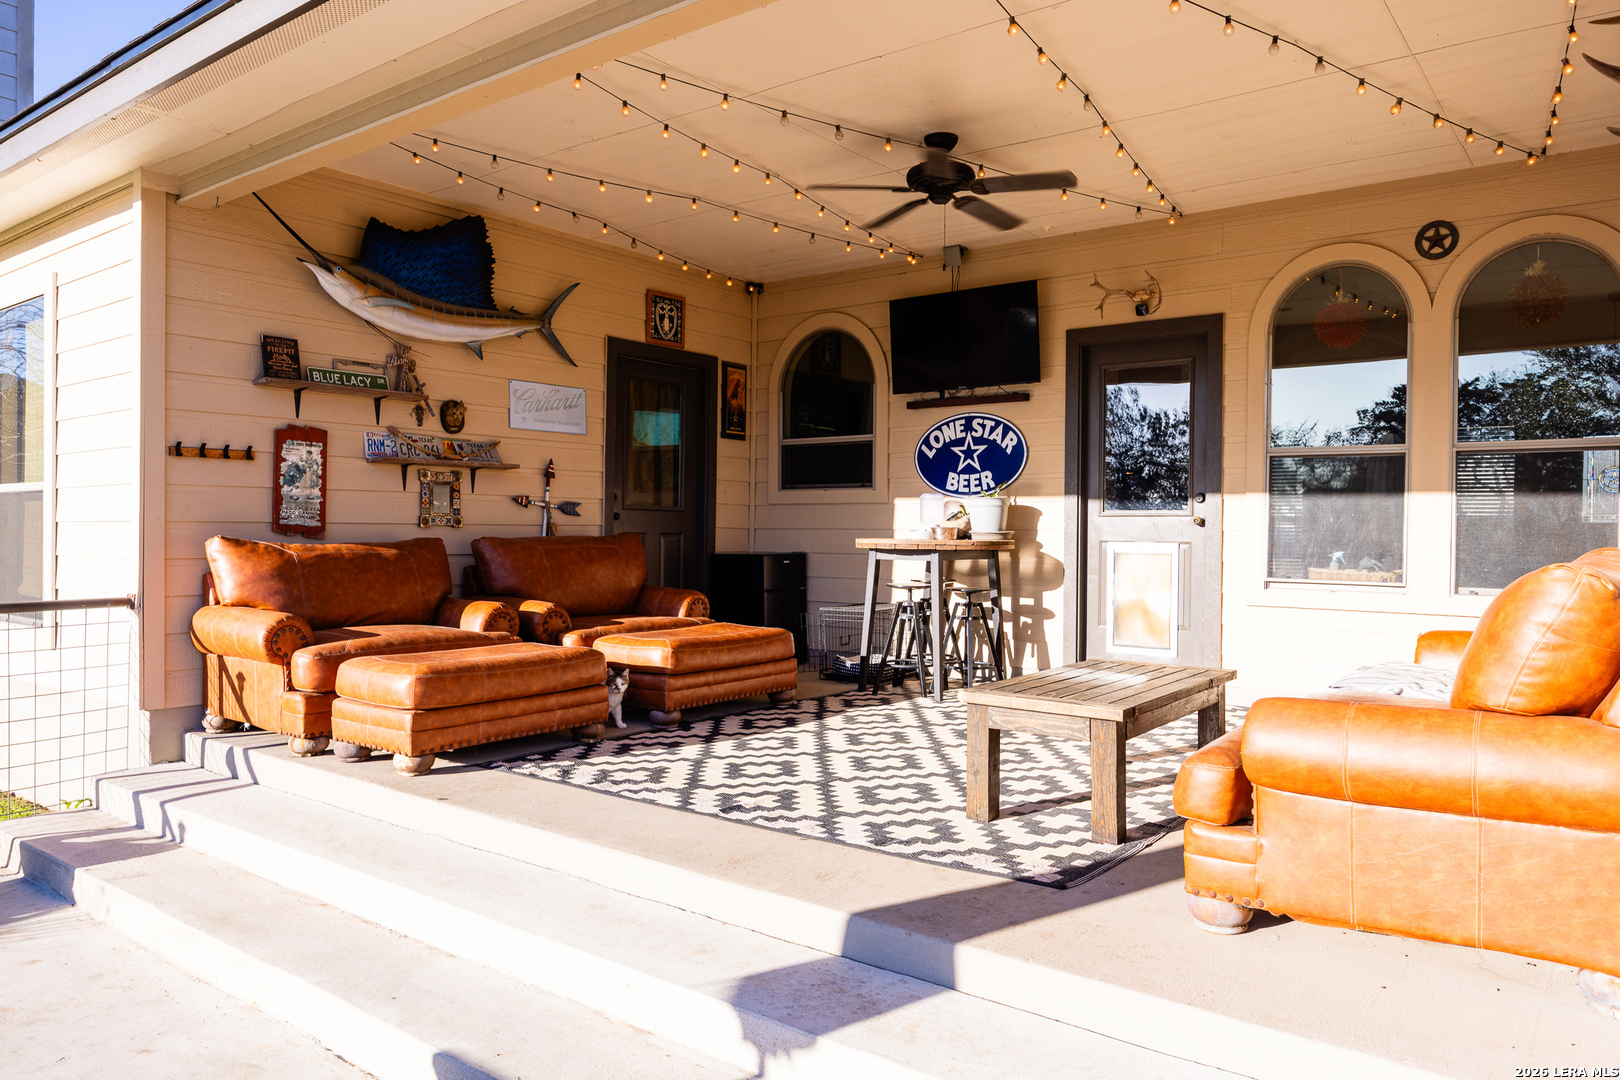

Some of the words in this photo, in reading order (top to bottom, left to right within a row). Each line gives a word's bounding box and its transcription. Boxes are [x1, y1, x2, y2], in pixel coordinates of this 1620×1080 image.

[267, 346, 295, 355] FIREPIT
[312, 371, 342, 385] BLUE
[343, 374, 371, 387] LACY
[513, 388, 583, 415] Carhartt
[921, 419, 966, 459] LONE
[971, 418, 1018, 455] STAR
[945, 470, 996, 493] BEER
